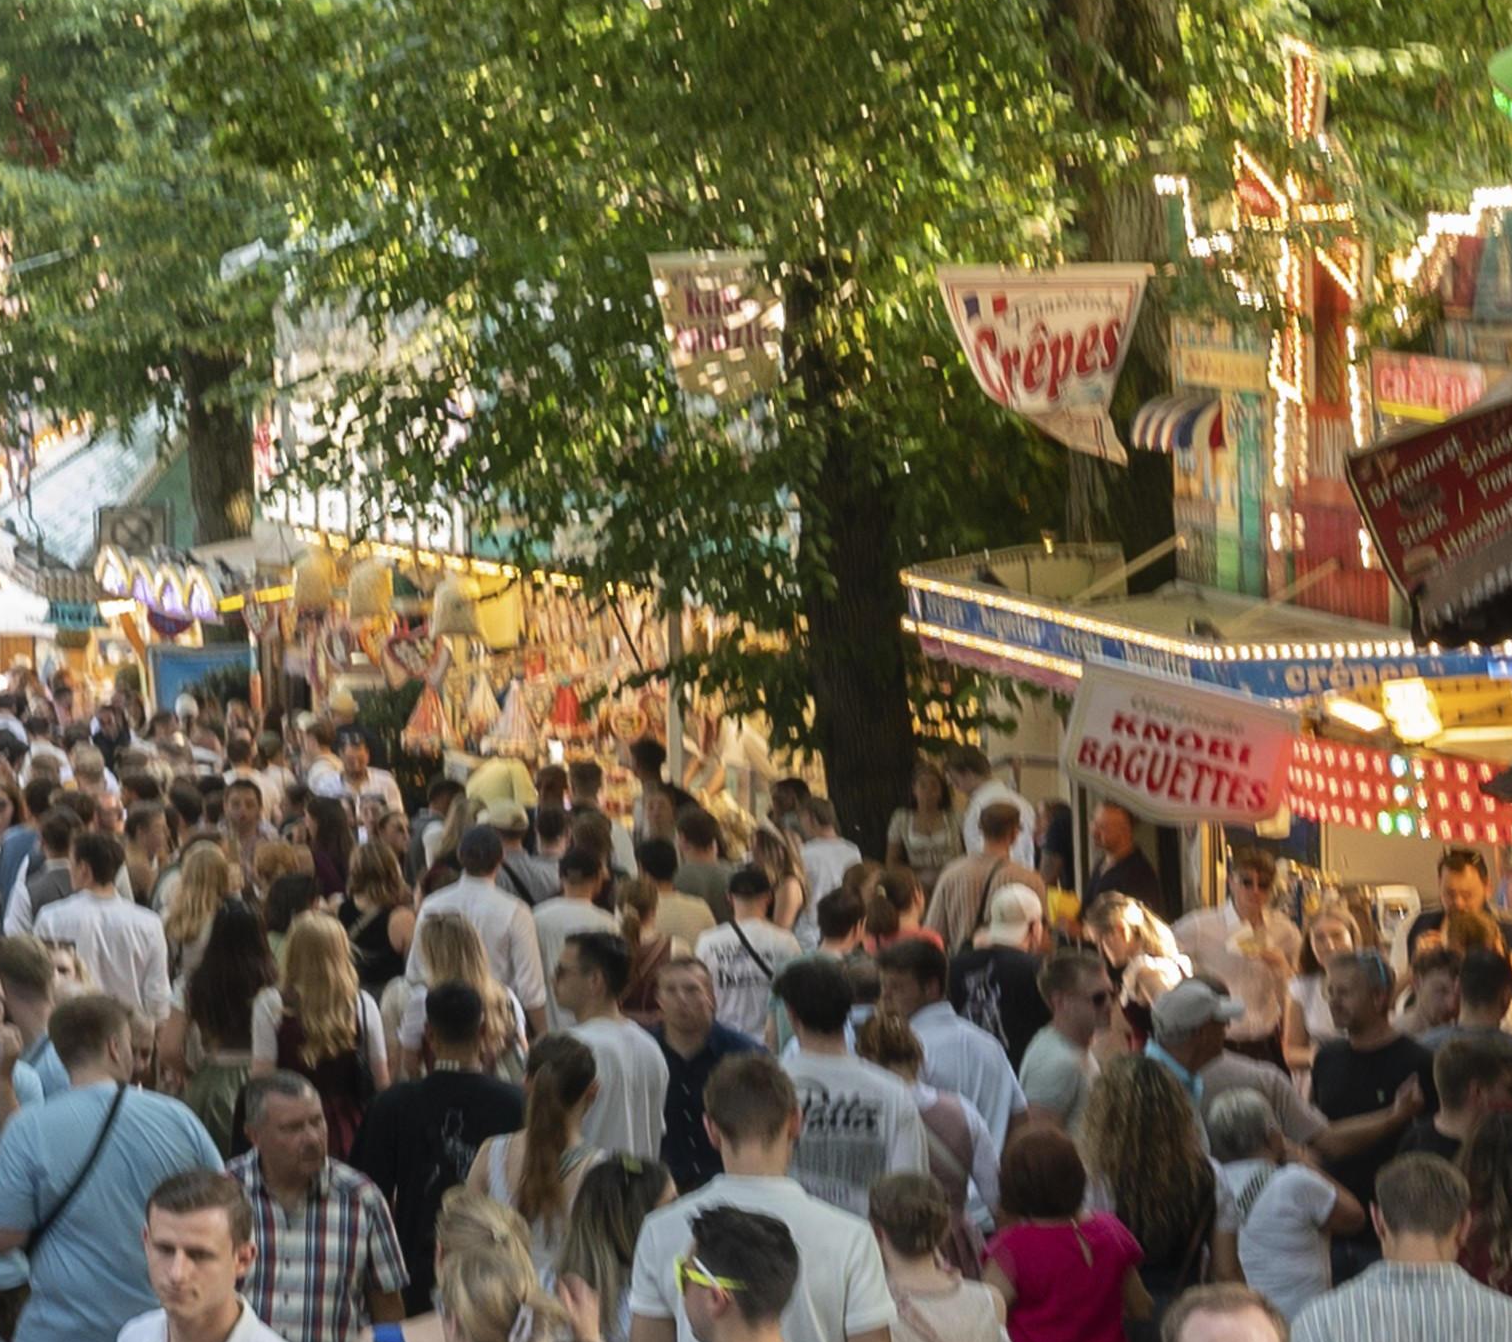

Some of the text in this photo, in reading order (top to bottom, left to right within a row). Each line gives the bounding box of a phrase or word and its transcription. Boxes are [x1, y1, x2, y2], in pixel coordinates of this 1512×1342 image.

[976, 319, 1122, 403] Crêpes
[1368, 433, 1464, 508] Bratwurst
[1397, 505, 1448, 550] Steak
[1078, 735, 1271, 812] BAGUETTES
[1111, 709, 1252, 765] KNOBI
